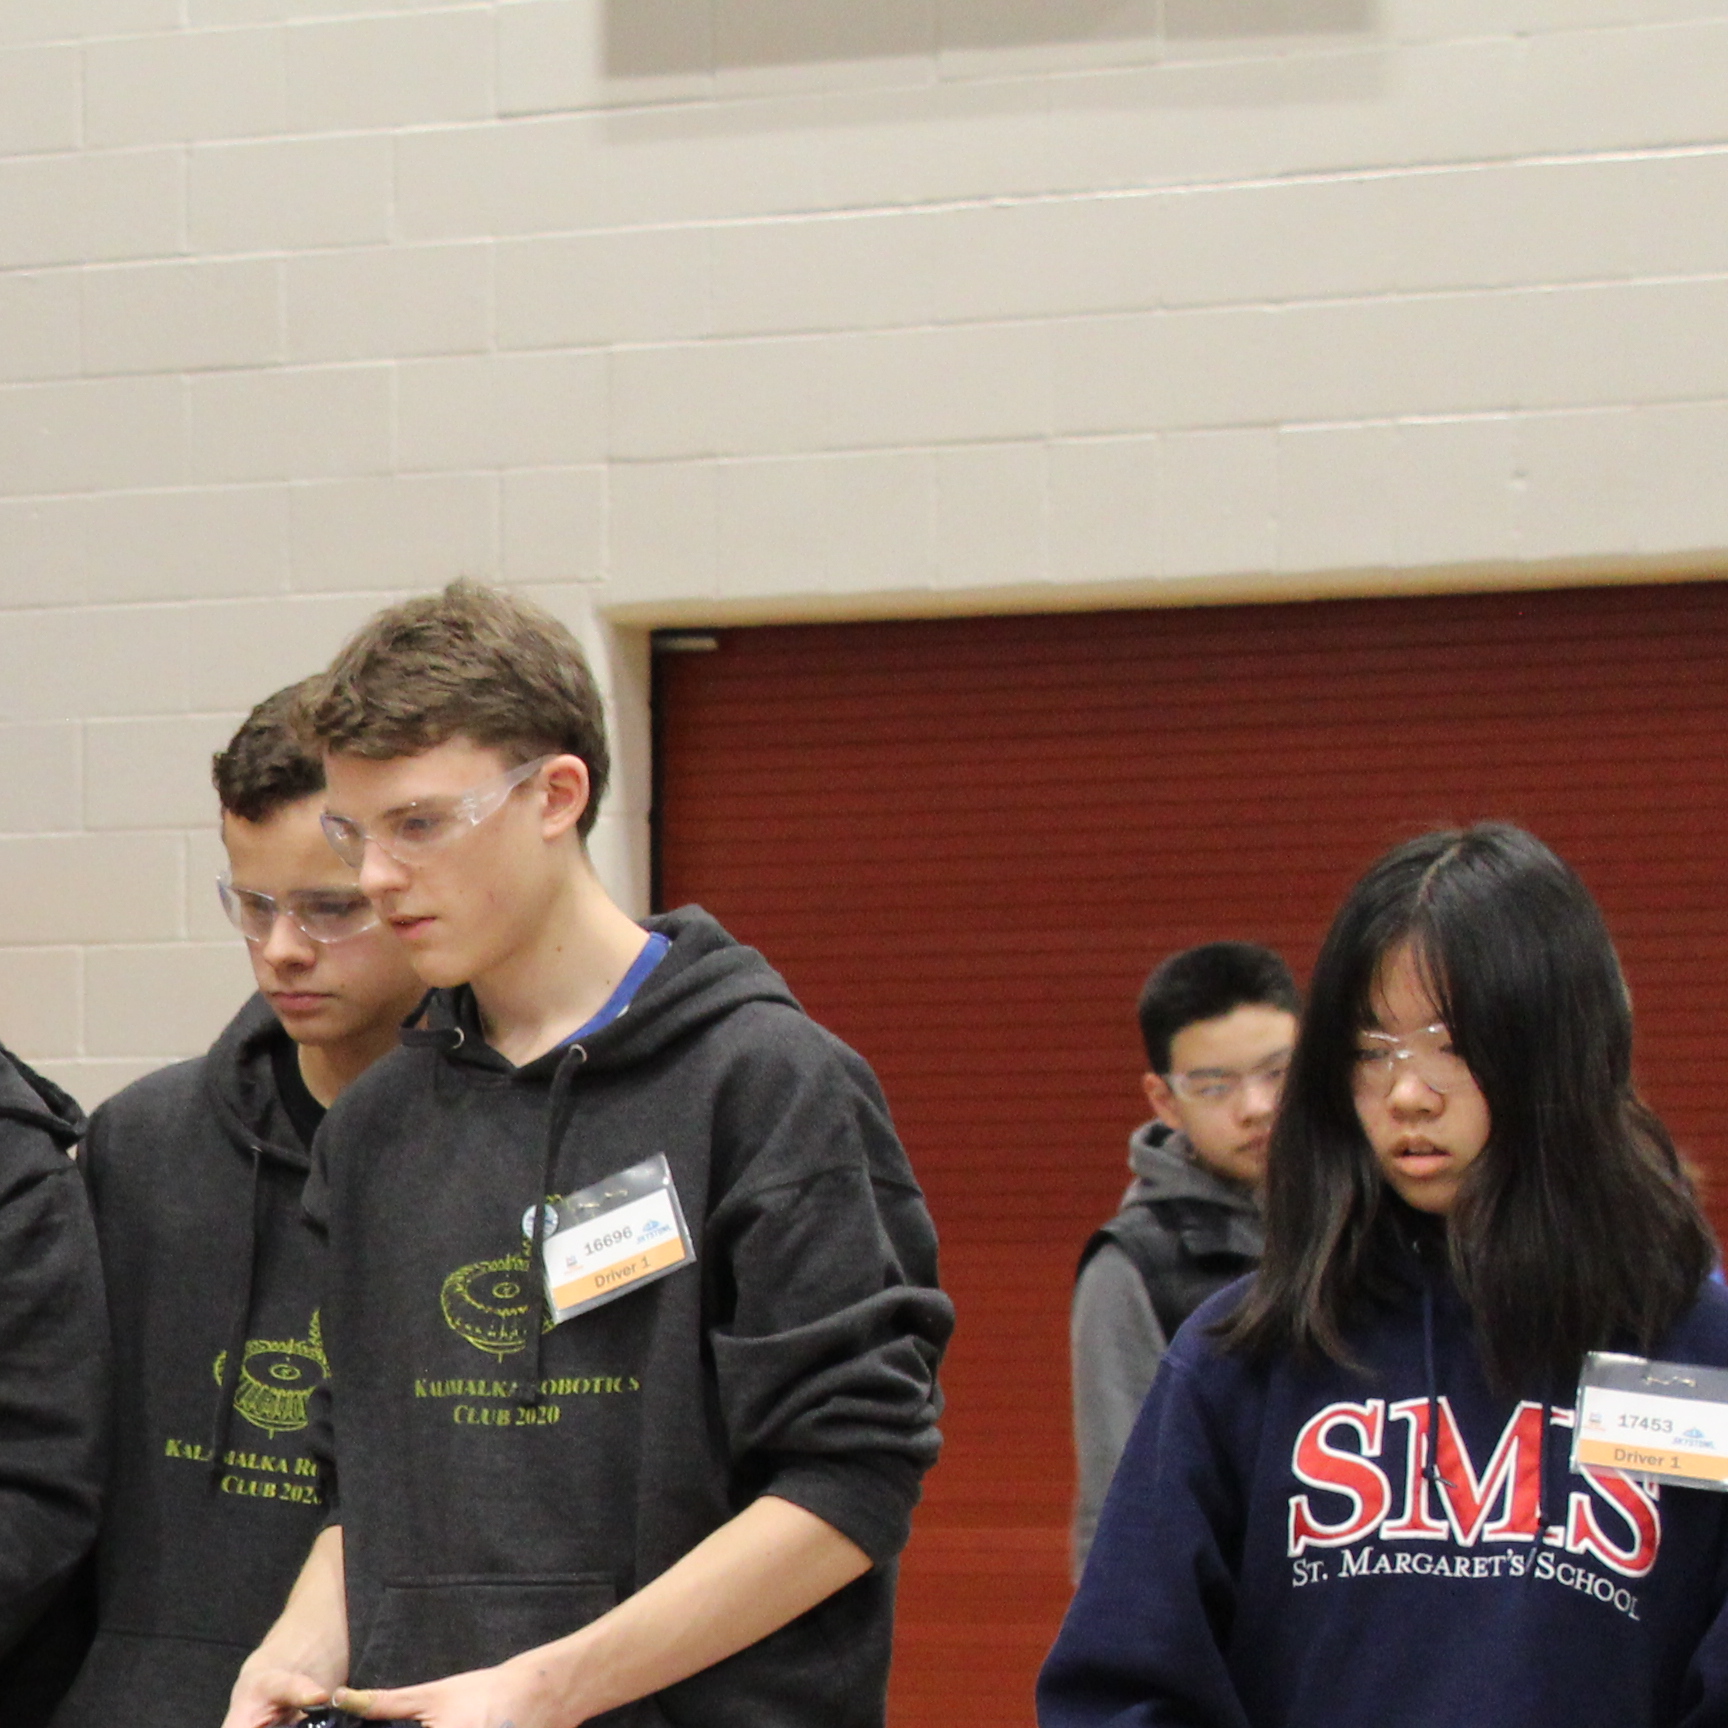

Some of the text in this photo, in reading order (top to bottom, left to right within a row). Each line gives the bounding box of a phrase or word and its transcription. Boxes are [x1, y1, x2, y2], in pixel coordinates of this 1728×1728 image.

[584, 1226, 633, 1256] 16696
[594, 1256, 651, 1288] Driver 1
[540, 1376, 641, 1397] OBOTICS
[453, 1404, 562, 1426] CLUB 2020
[1618, 1413, 1673, 1433] 17453
[165, 1438, 288, 1474] KALALKA
[1614, 1448, 1681, 1469] Driver 1
[220, 1475, 277, 1498] CLUB
[1287, 1396, 1661, 1578] SMS
